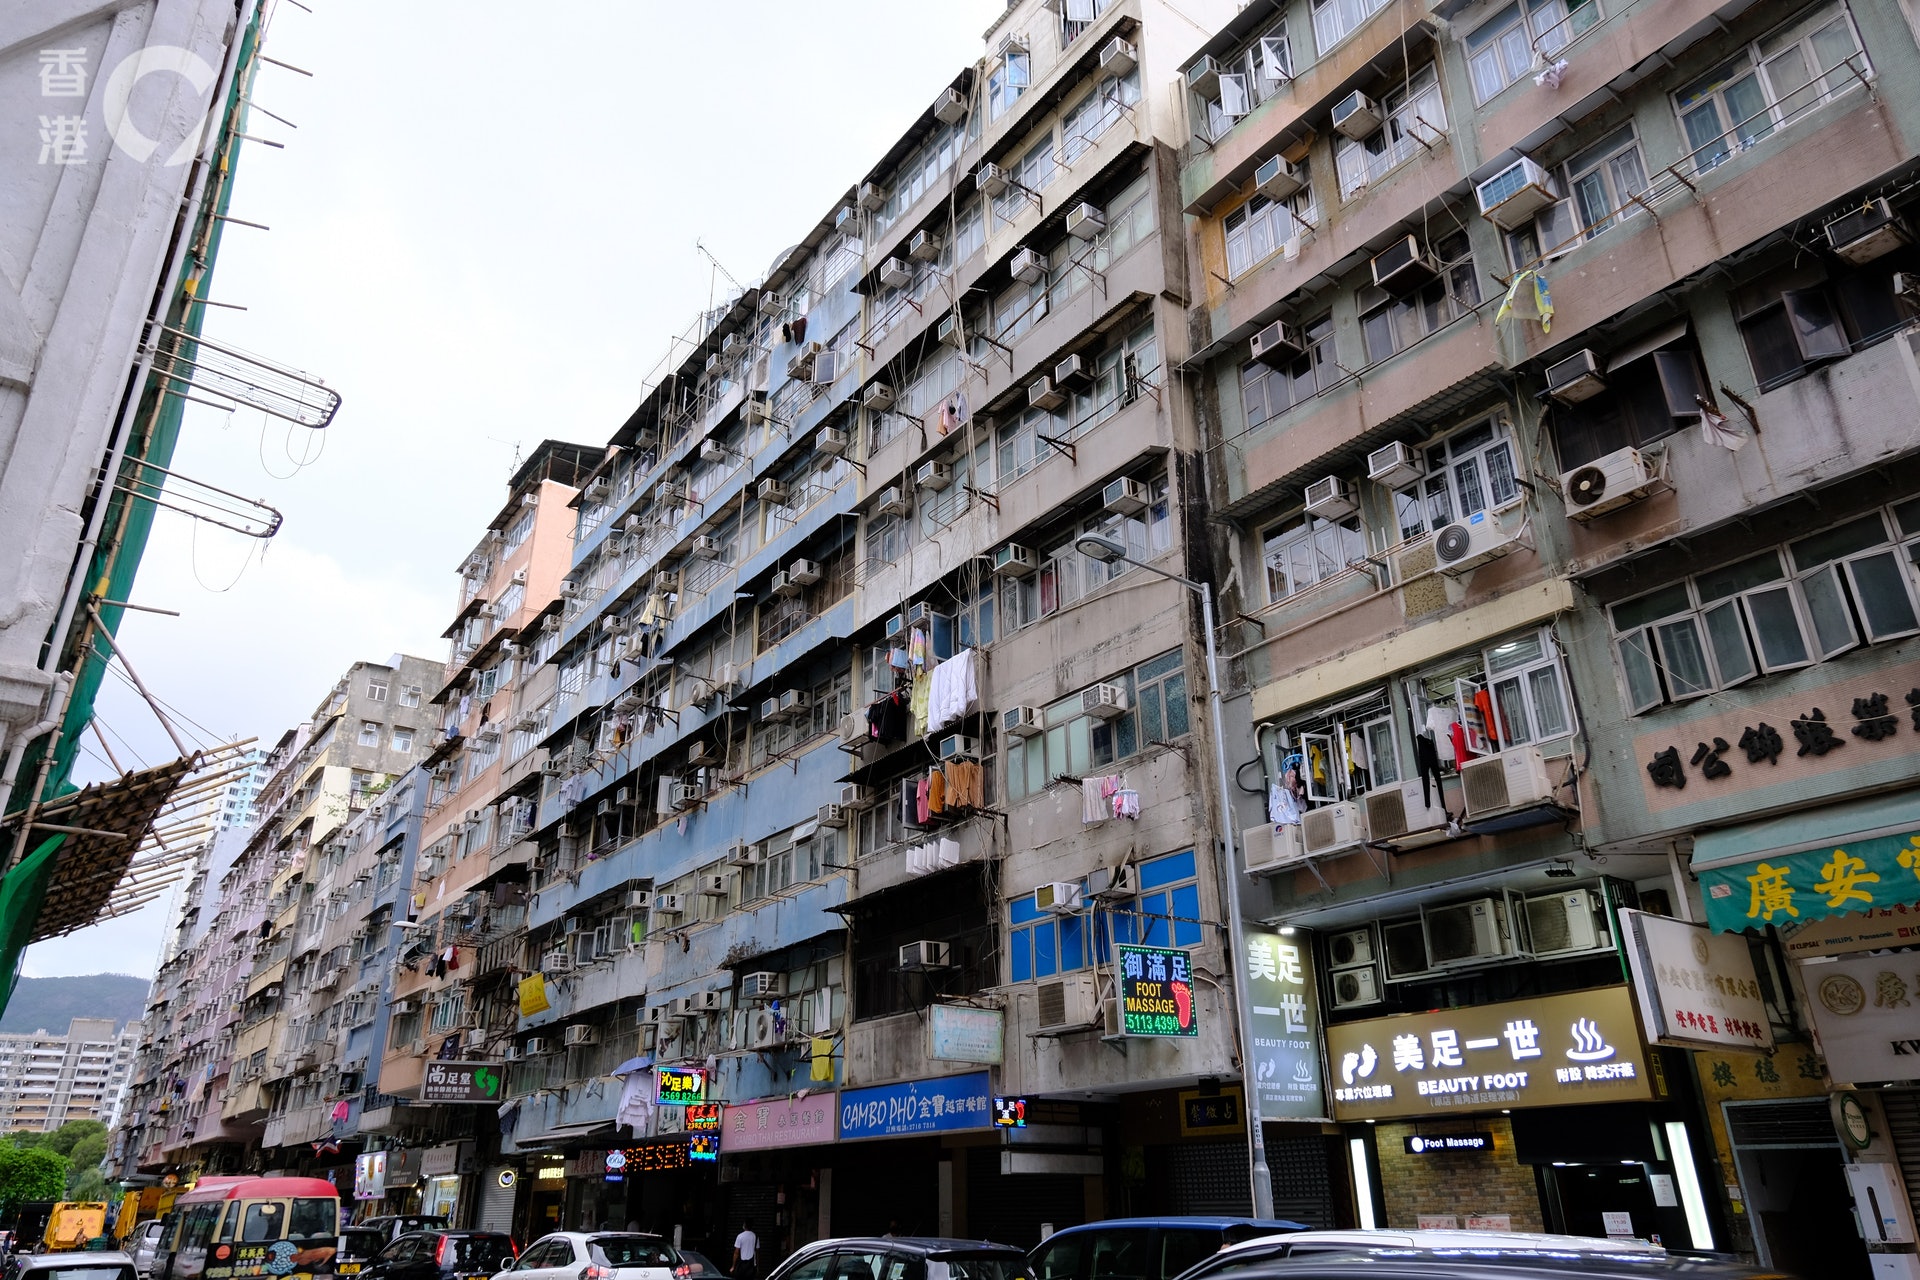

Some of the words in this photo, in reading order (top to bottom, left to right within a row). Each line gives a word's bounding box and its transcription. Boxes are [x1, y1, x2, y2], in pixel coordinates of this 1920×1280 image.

[1747, 835, 1920, 921] 廣安
[1795, 940, 1820, 950] CLIPSAL
[1825, 936, 1853, 945] PHILIPS
[1858, 931, 1894, 941] Panasonic
[1124, 951, 1189, 983] 御滿足
[1248, 940, 1304, 984] 美足
[1136, 982, 1162, 998] FOOT
[1126, 997, 1175, 1014] MASSAGE
[1253, 994, 1307, 1034] 一世
[1127, 1014, 1153, 1030] 5113
[1154, 1015, 1179, 1031] 4390
[1254, 1037, 1286, 1049] BEAUTY
[1288, 1039, 1311, 1050] FOOT
[1392, 1019, 1543, 1072] 美足一世
[428, 1065, 472, 1085] 尚足堂
[661, 1072, 693, 1092] 沁足樂
[1417, 1076, 1480, 1095] BEAUTY
[1484, 1072, 1528, 1090] FOOT
[660, 1091, 680, 1100] 2569
[842, 1101, 887, 1131] CAMBO
[735, 1133, 757, 1146] CAMBO
[760, 1132, 773, 1142] THAI
[775, 1126, 820, 1142] RESTAURANT
[1424, 1138, 1444, 1149] Foot
[1446, 1136, 1484, 1148] Massage
